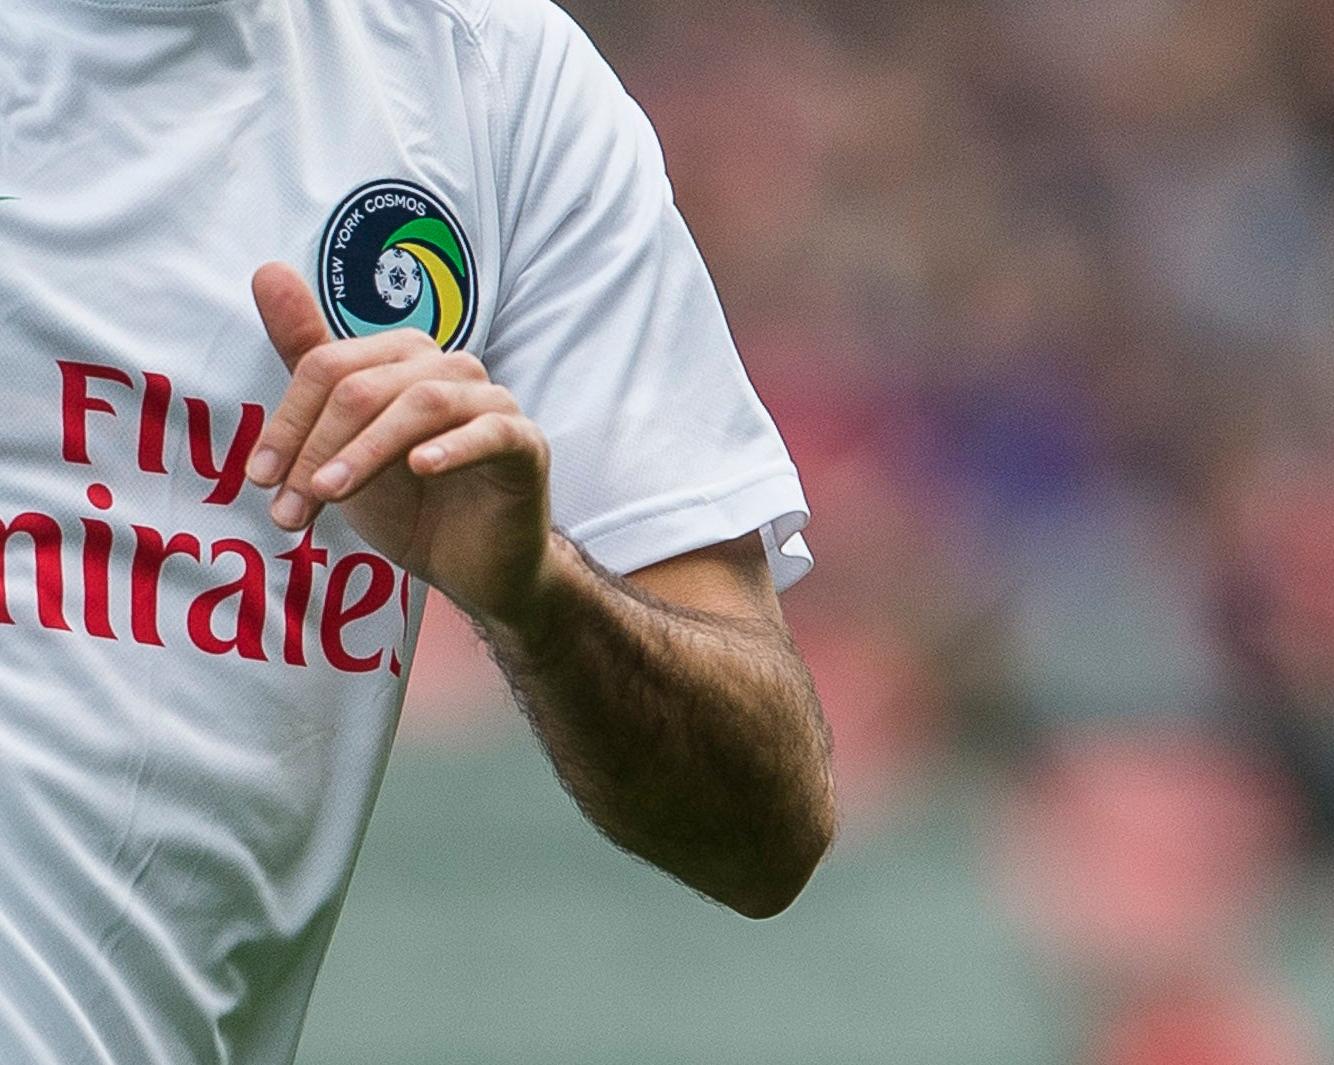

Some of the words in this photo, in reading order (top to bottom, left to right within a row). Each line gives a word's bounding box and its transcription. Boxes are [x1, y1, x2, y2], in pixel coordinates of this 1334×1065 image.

[365, 194, 427, 216] COSMOS
[335, 208, 364, 250] YORK
[331, 256, 346, 299] NEW
[57, 360, 265, 505] Fly
